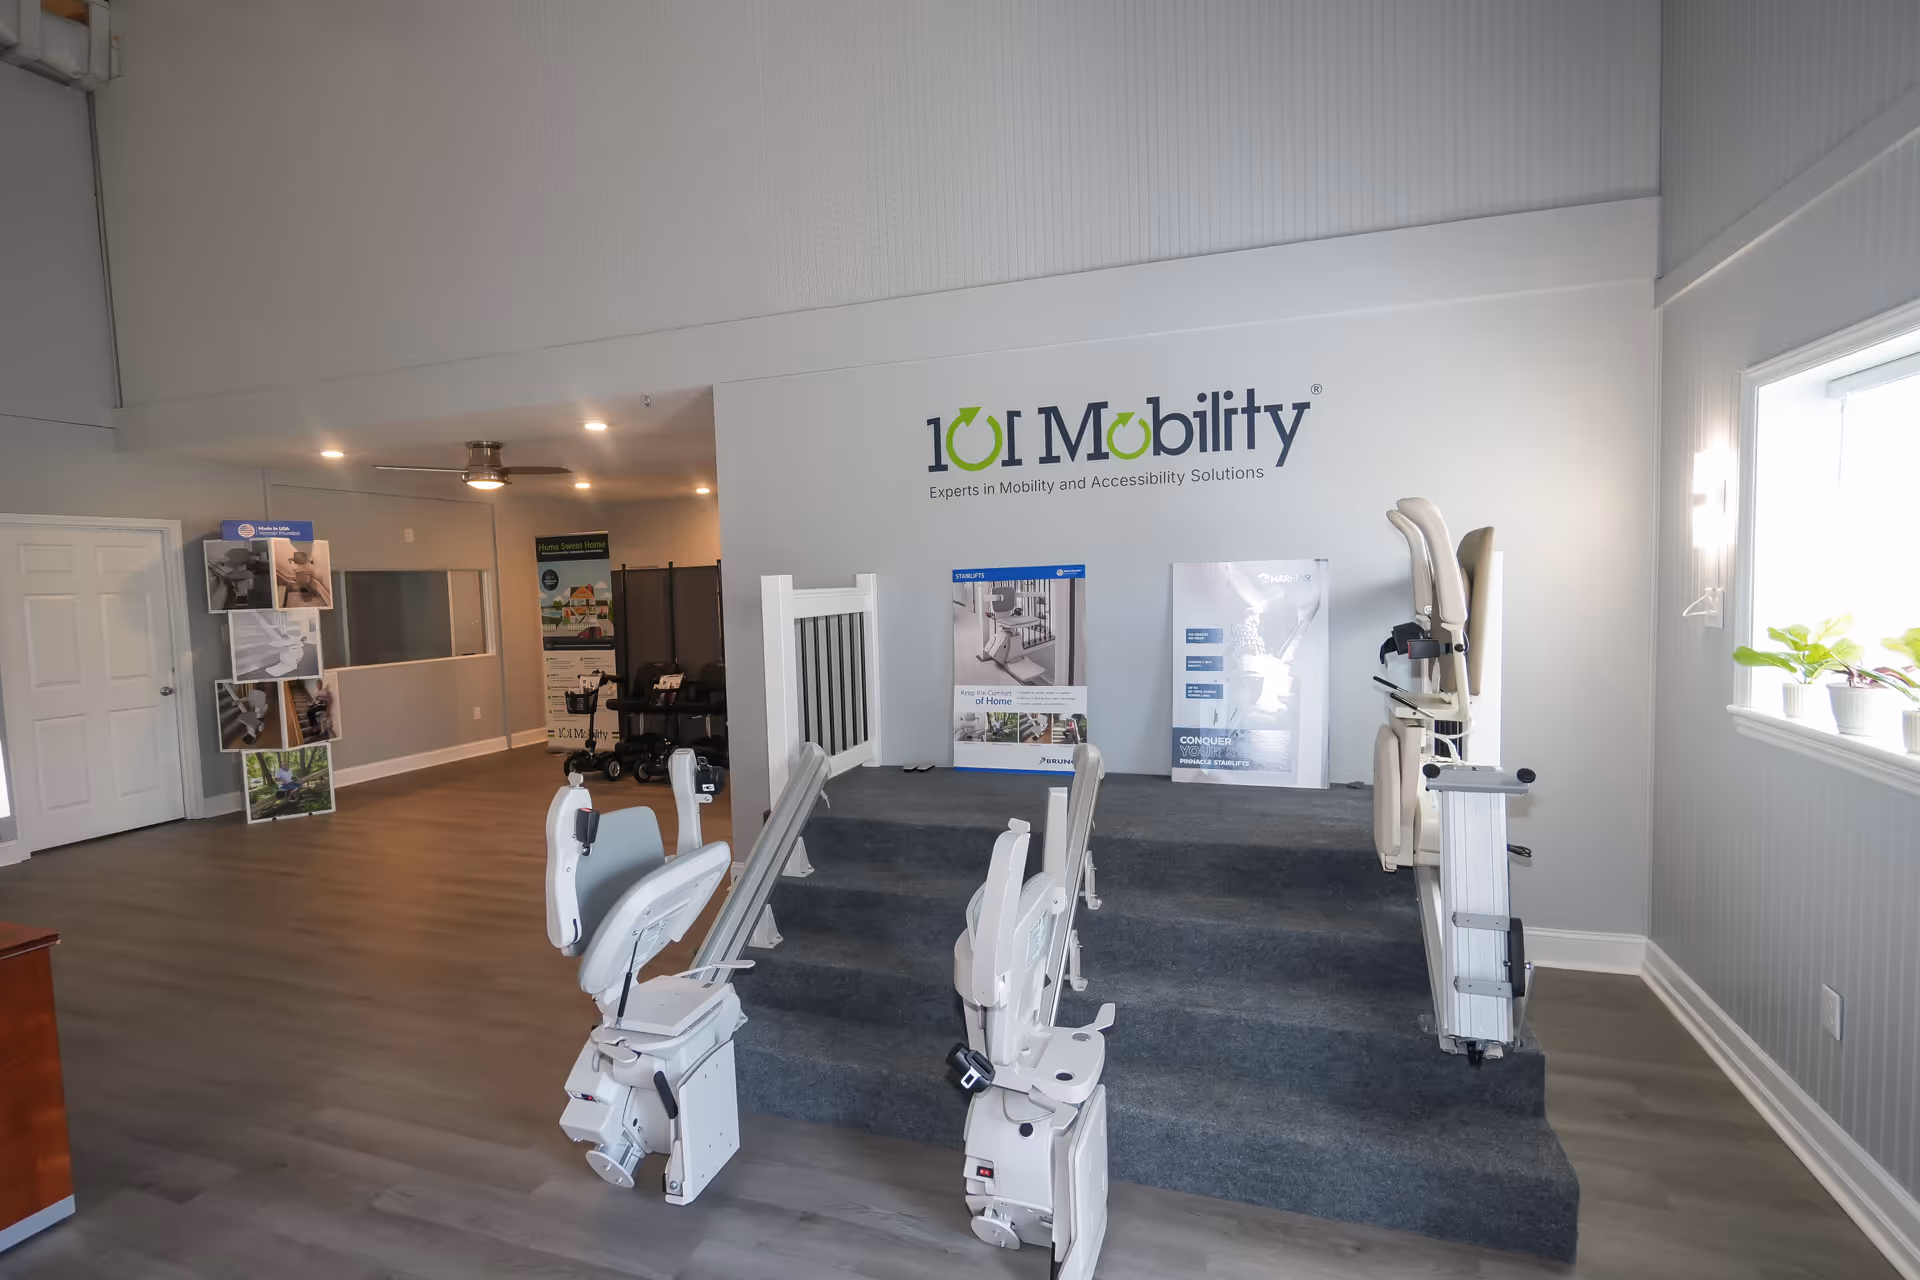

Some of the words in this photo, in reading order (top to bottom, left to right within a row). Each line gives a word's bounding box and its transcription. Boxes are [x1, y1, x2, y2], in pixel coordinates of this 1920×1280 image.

[927, 407, 1023, 472] 101
[1037, 388, 1311, 468] Mobility
[929, 486, 980, 500] Experts
[983, 483, 995, 495] in
[1000, 479, 1055, 494] Mobility
[1059, 477, 1086, 490] and
[1091, 470, 1186, 488] Accessibility
[1191, 467, 1265, 482] Solutions
[584, 541, 606, 549] Home
[975, 697, 984, 705] of
[986, 697, 1013, 705] Home
[1180, 736, 1232, 746] CONQUER
[1180, 745, 1221, 757] YOUR
[1180, 758, 1212, 766] PINNACLE
[1214, 759, 1250, 767] STAIRLIFTS
